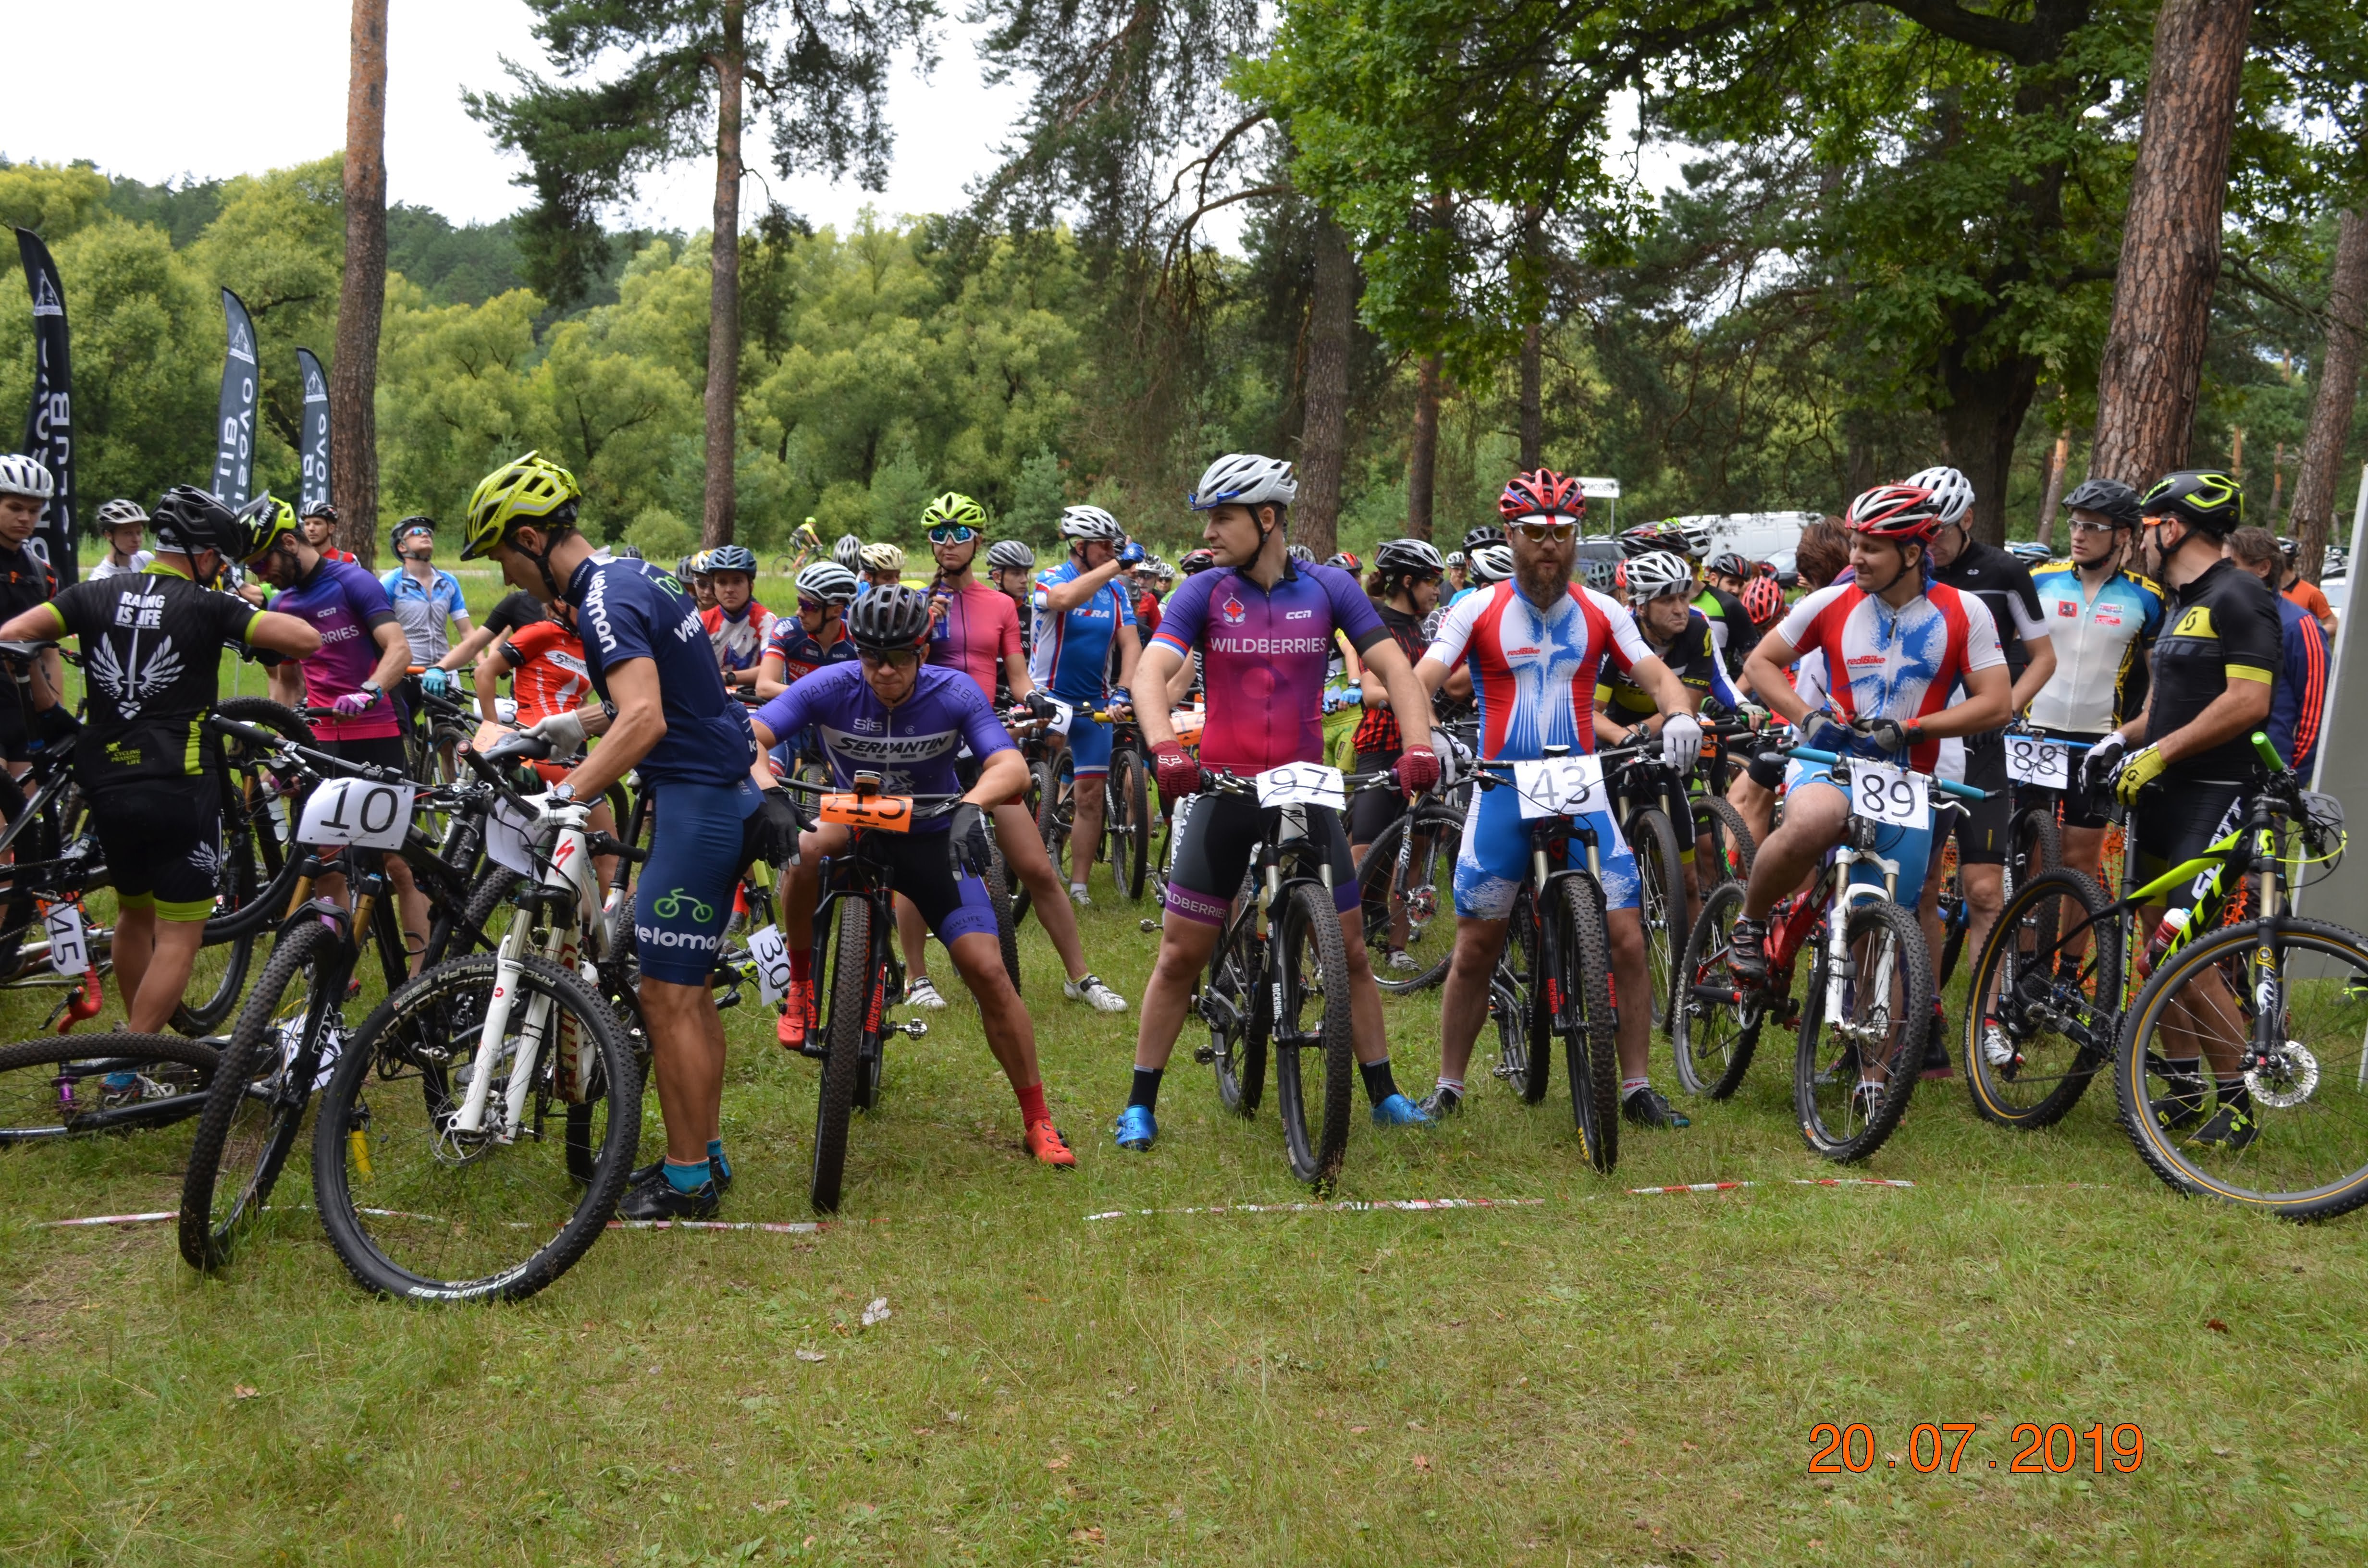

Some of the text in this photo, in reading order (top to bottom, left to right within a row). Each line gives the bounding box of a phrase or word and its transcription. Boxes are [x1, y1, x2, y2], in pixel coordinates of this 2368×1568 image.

[116, 605, 134, 624] IS
[585, 570, 617, 653] veloman
[1210, 637, 1327, 654] WILDBERRIES
[1847, 655, 1886, 665] redBike
[833, 735, 949, 754] SERPANTIN
[2013, 741, 2058, 775] 88
[1270, 768, 1329, 796] 97
[1530, 766, 1591, 806] 43
[1862, 774, 1915, 817] 89
[320, 781, 398, 833] 10
[49, 915, 80, 965] 45
[635, 924, 716, 950] eloma
[437, 963, 495, 983] RALPH
[760, 936, 790, 989] 30
[806, 979, 817, 1029] BRAIN
[1676, 971, 1687, 1025] TUBELESS
[407, 1265, 528, 1299] SCHWALBE
